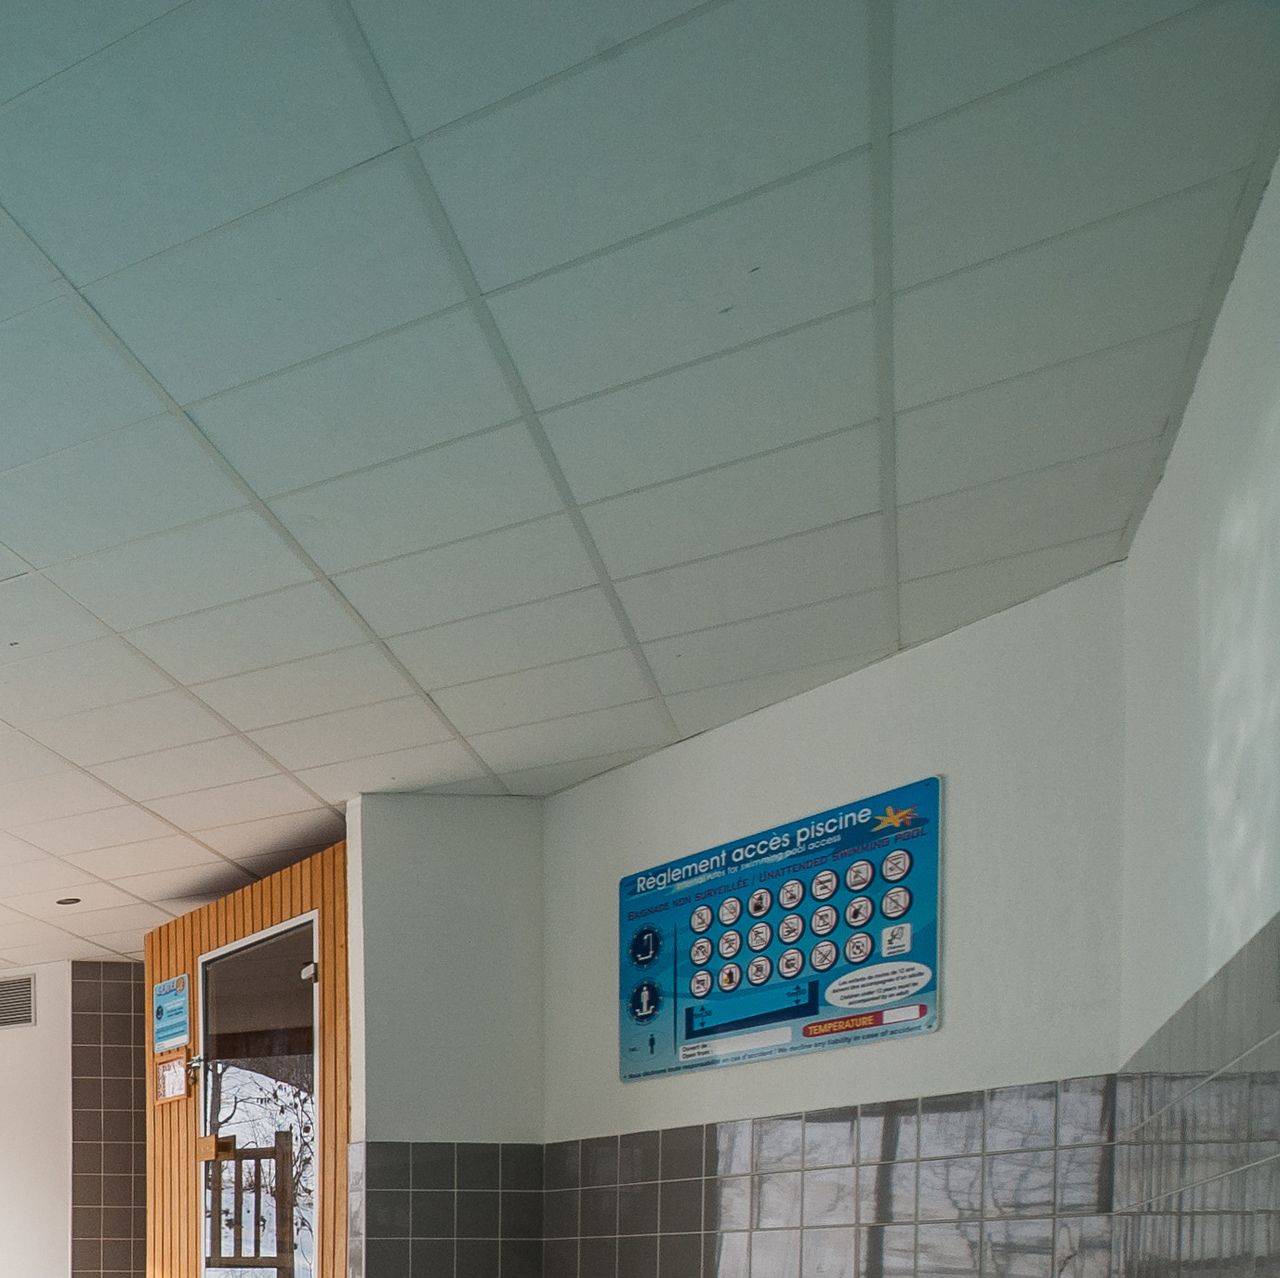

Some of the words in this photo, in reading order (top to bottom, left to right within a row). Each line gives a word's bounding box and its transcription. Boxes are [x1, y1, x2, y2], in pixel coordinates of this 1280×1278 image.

[637, 850, 726, 892] Règlement
[731, 832, 790, 863] accès
[797, 808, 872, 848] piscine
[727, 865, 739, 873] for
[782, 845, 805, 857] pool
[807, 835, 841, 849] access
[807, 1015, 874, 1036] TEMPERATURE
[681, 1051, 696, 1059] Open
